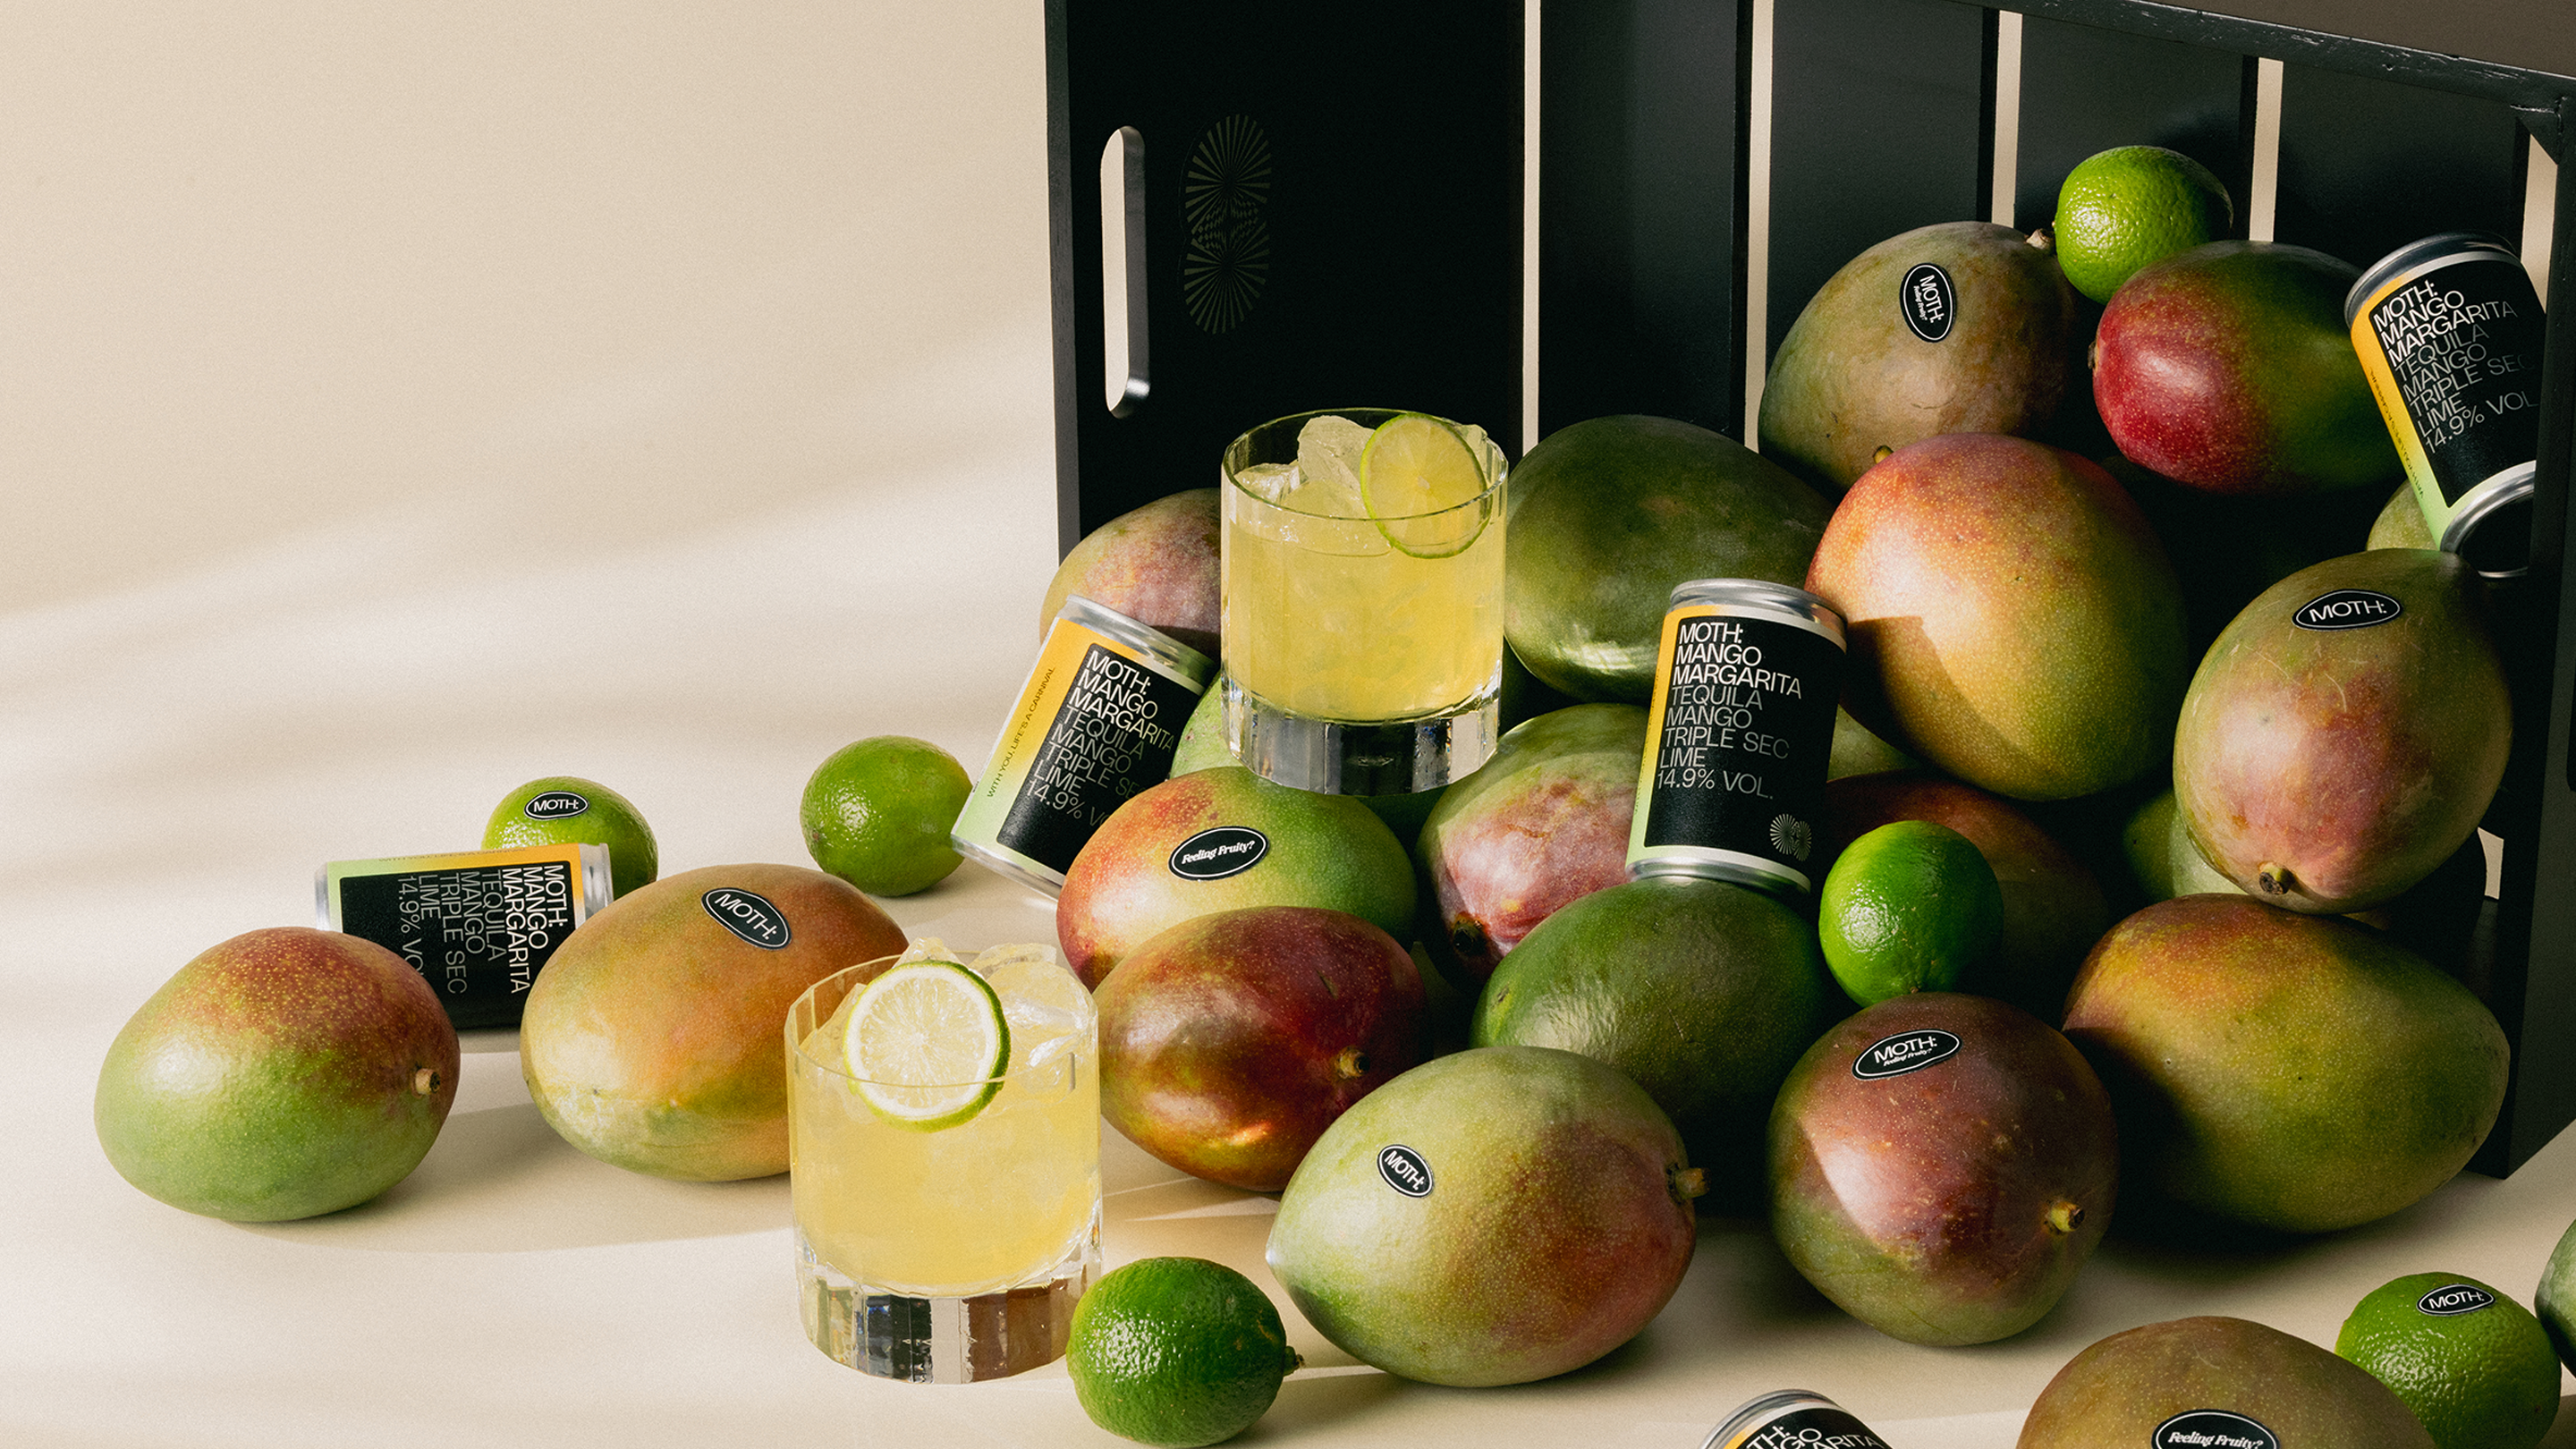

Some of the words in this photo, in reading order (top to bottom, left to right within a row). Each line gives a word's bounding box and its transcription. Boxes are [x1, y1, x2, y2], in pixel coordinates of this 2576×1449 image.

[1919, 275, 1945, 324] MOTH:
[2373, 279, 2438, 333] MOTH:
[2380, 290, 2465, 351] MANGO
[2387, 301, 2519, 367] MARGARITA
[2394, 324, 2490, 382] TEQUILA
[2402, 343, 2487, 402] MANGO
[2410, 367, 2483, 417] TRIPLE
[2487, 353, 2535, 376] SEC
[2418, 391, 2466, 438] LIME
[2425, 404, 2486, 454] 14.9%
[1679, 622, 1743, 645] MOTH:
[2309, 599, 2387, 623] MOTH:
[1086, 650, 1151, 695] MOTH:
[1676, 642, 1762, 667] MANGO
[1029, 667, 1056, 712] CARNIVAL
[1077, 669, 1158, 720] MANGO
[1672, 684, 1763, 711] TEQUILA
[1673, 663, 1802, 699] MARGARITA
[1026, 713, 1033, 722] A
[1059, 704, 1145, 760] TEQUILA
[1068, 687, 1175, 753] MARGARITA
[1666, 706, 1752, 729] MANGO
[1041, 741, 1115, 788] TRIPLE
[1050, 724, 1131, 774] MANGO
[1660, 746, 1708, 768] LIME
[1665, 726, 1736, 749] TRIPLE
[1742, 731, 1789, 759] SEC
[987, 772, 1003, 798] WITH
[1027, 778, 1087, 820] 14.9%
[1034, 759, 1087, 798] LIME
[1657, 767, 1716, 790] 14.9%
[1723, 770, 1774, 800] VOL.
[533, 799, 580, 813] MOTH:
[1182, 847, 1217, 865] Feeling
[1217, 840, 1256, 856] Fruity?
[397, 875, 421, 934] 14.9%
[419, 874, 441, 920] LIME
[440, 872, 464, 943] TRIPLE
[461, 871, 486, 954] MANGO
[481, 869, 507, 962] TEQUILA
[522, 867, 549, 949] MANGO
[544, 865, 568, 927] MOTH:
[714, 893, 777, 941] MOTH:
[502, 868, 530, 994] MARGARITA
[402, 937, 425, 976] VO
[445, 951, 468, 994] SEC
[1874, 1035, 1937, 1063] MOTH:
[1384, 1150, 1425, 1191] MOTH:
[2428, 1291, 2485, 1309] MOTH:
[2167, 1431, 2216, 1447] Feeling
[2215, 1435, 2264, 1449] Fruity?
